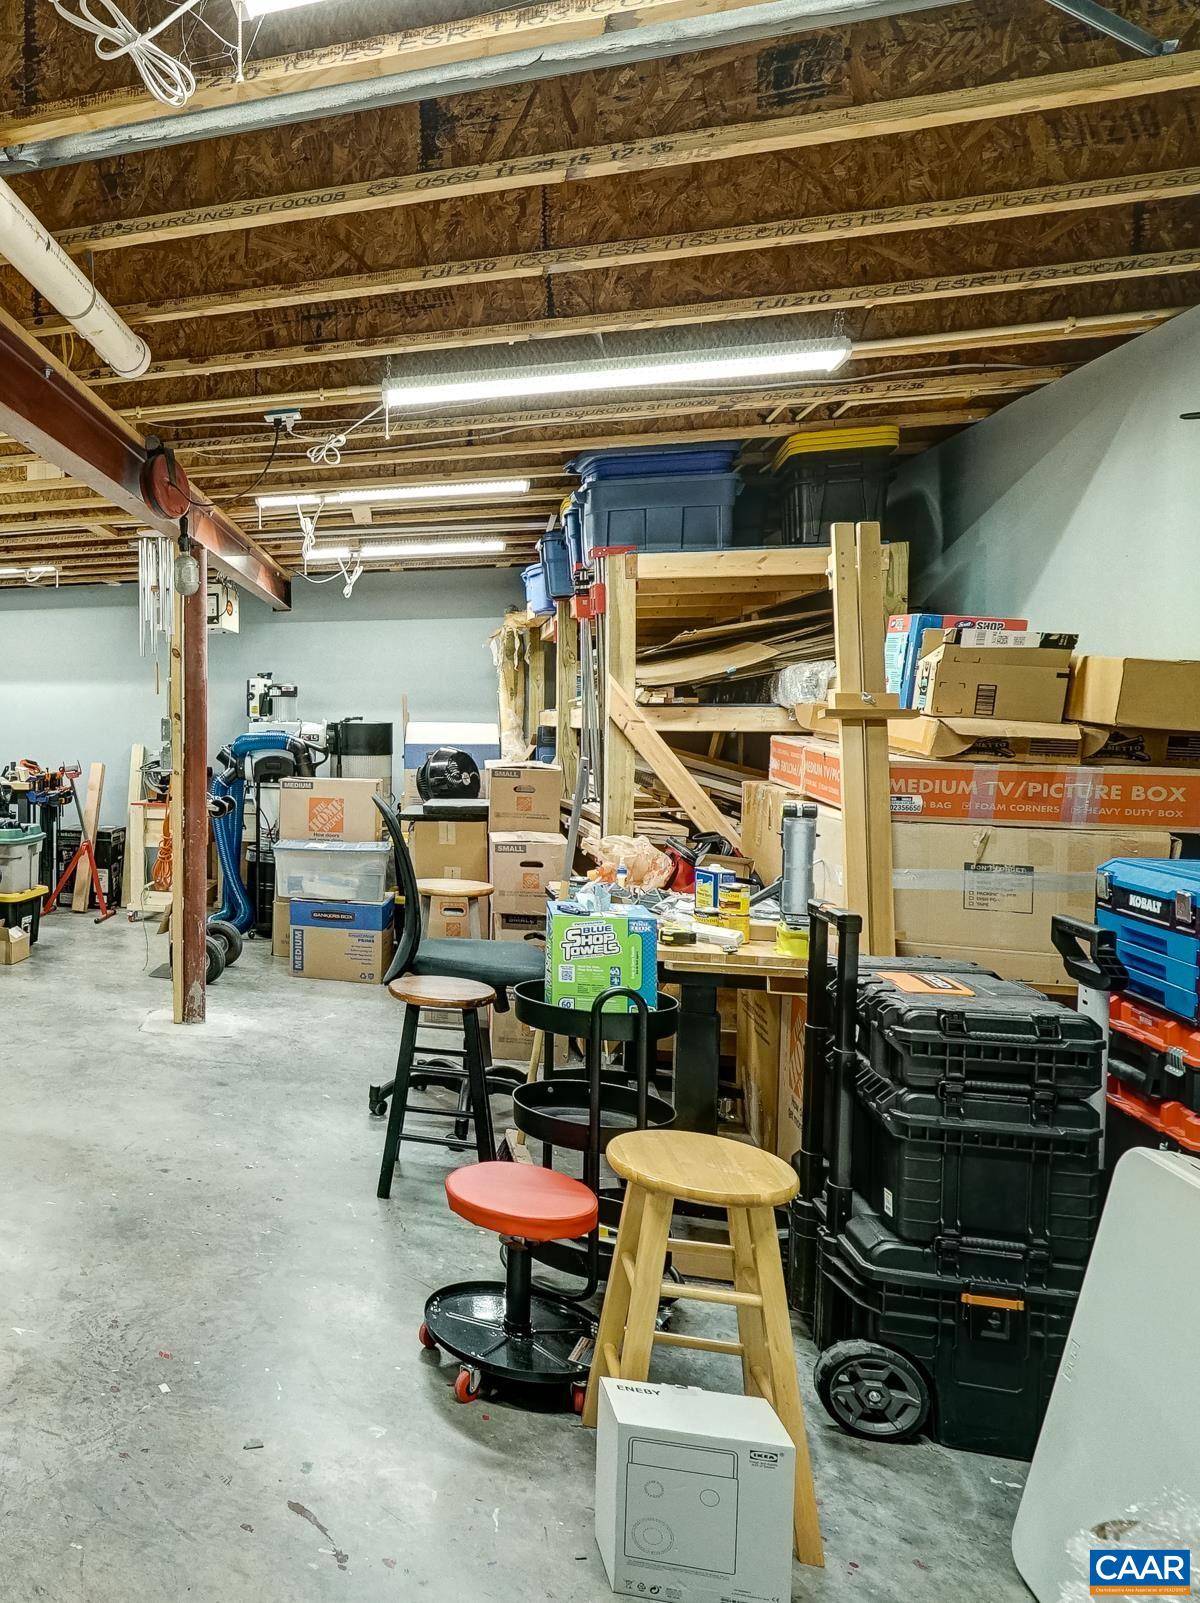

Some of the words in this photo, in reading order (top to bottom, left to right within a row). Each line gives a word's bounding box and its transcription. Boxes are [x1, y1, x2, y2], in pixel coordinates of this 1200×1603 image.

[54, 225, 116, 245] TIFIED
[120, 208, 235, 234] SOURCING
[240, 191, 347, 216] SFI-00008
[420, 265, 452, 279] TJI
[457, 261, 496, 275] 210
[513, 249, 590, 268] ICCES
[1003, 178, 1154, 208] CERTIFIED
[849, 282, 924, 301] ICCES
[494, 770, 520, 778] SMALL
[283, 781, 313, 789] MEDIUM
[890, 778, 979, 795] MEDIUM
[1131, 785, 1187, 802] BOX
[930, 801, 953, 809] BAG
[975, 802, 1007, 811] FOAM
[1009, 804, 1060, 814] CORNERS
[1124, 808, 1155, 817] DUTY
[1157, 809, 1184, 818] BOX
[497, 845, 525, 853] SMALL
[1128, 893, 1163, 914] KOBALT
[566, 927, 616, 946] SHOP
[582, 925, 613, 934] BLUE
[294, 930, 303, 970] MEDIUM
[561, 940, 621, 961] TOWELS
[616, 1384, 661, 1396] ENEBY
[753, 1452, 775, 1460] IKEA
